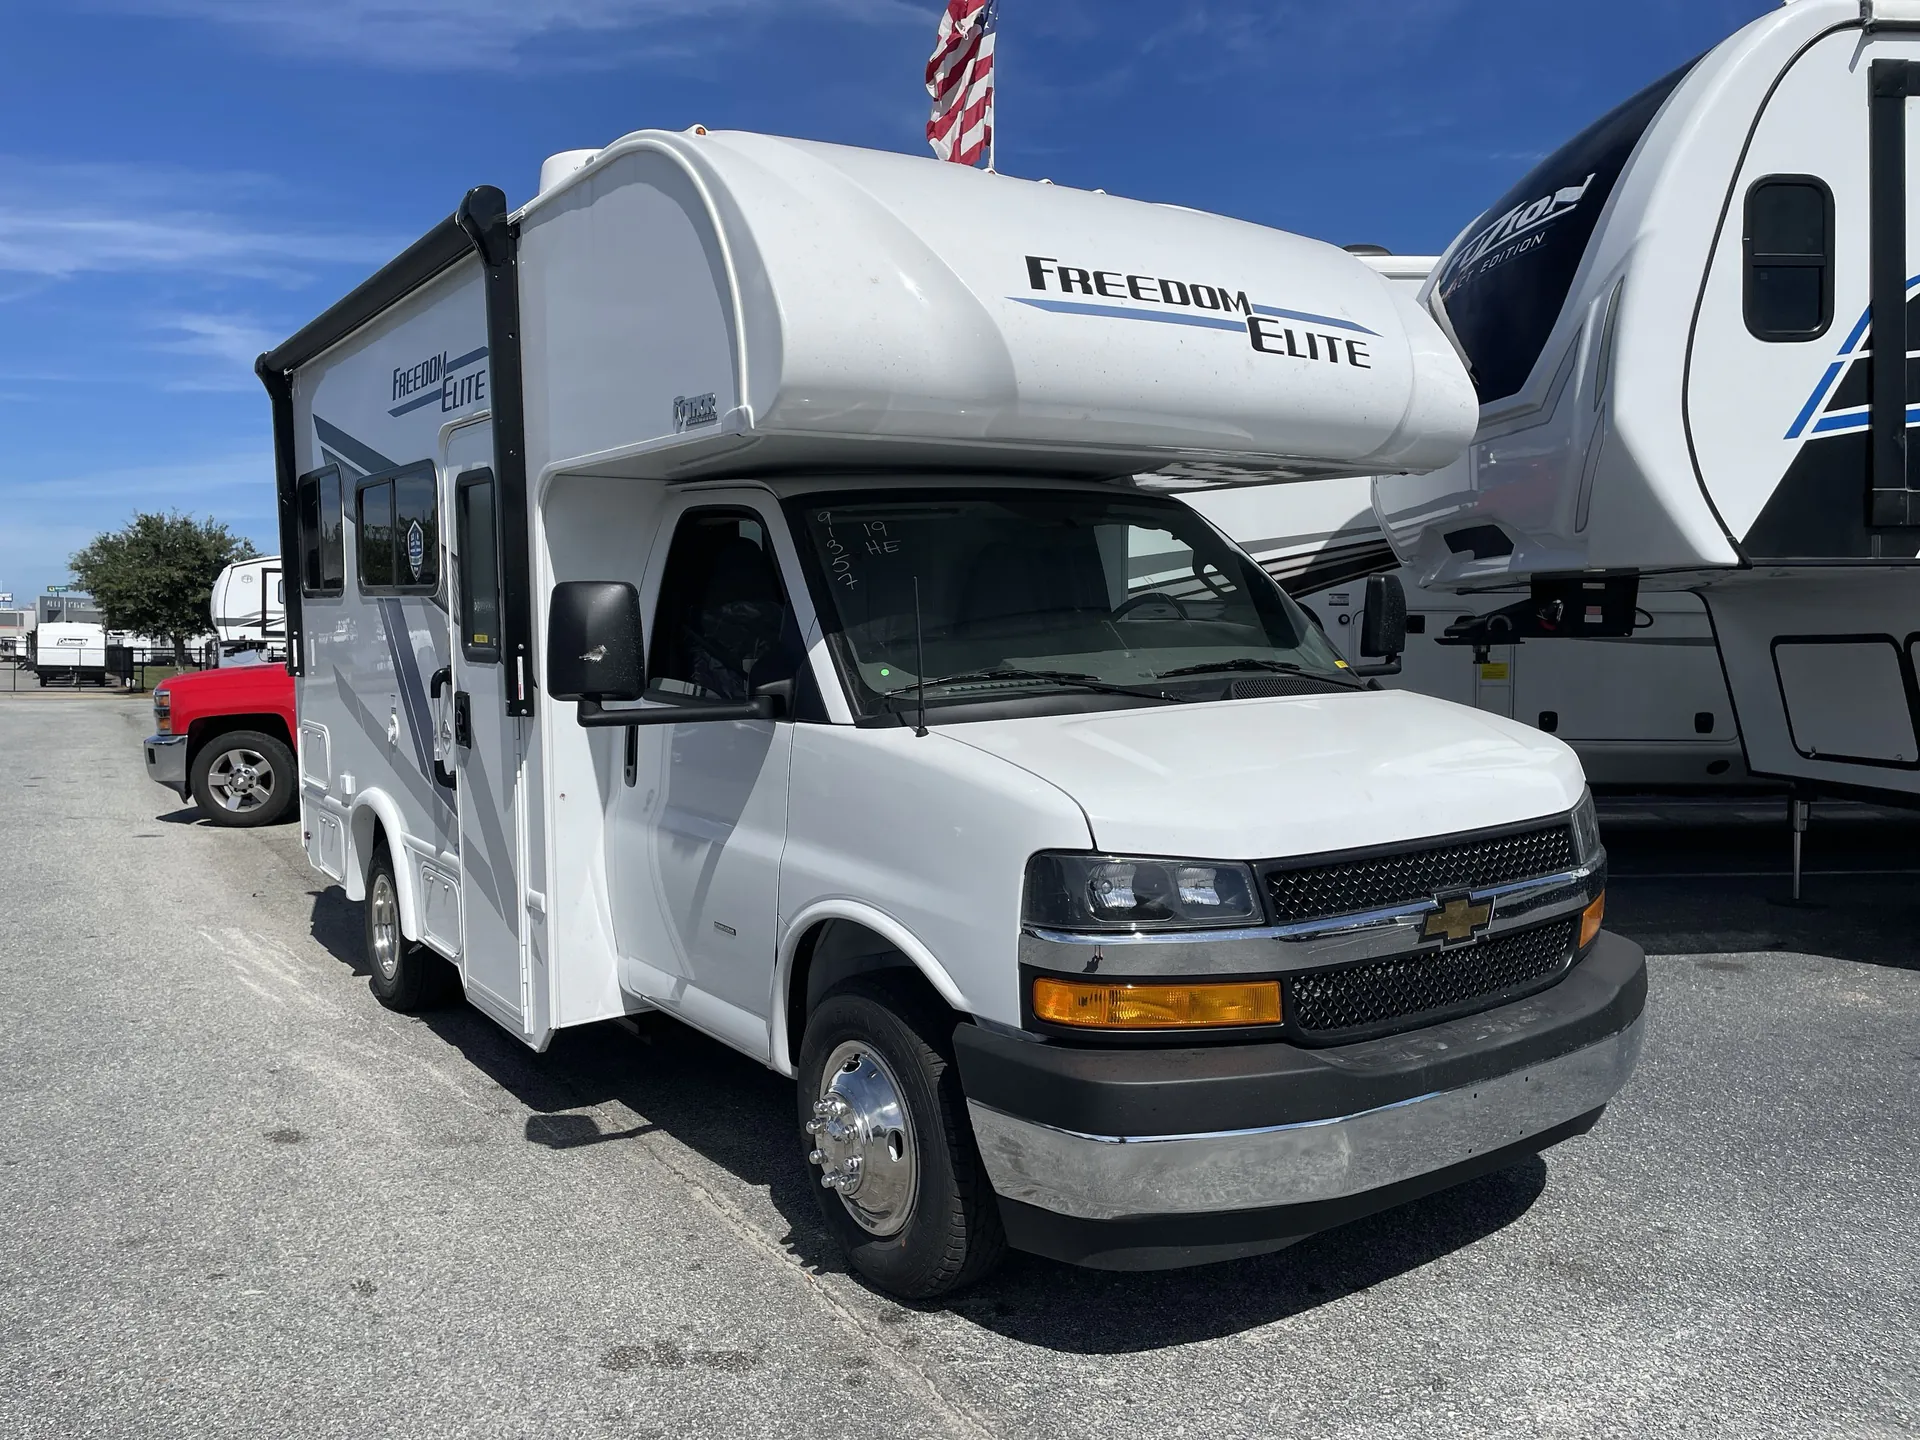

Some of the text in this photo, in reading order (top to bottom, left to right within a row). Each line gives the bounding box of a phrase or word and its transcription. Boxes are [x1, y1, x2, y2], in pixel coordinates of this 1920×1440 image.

[1480, 232, 1546, 274] EDITION
[1025, 255, 1252, 316] FREEDOM
[1247, 316, 1372, 369] ELITE
[392, 351, 448, 401] FREEDOM
[441, 369, 486, 413] ELITE
[863, 521, 888, 537] 19
[865, 539, 901, 555] HE
